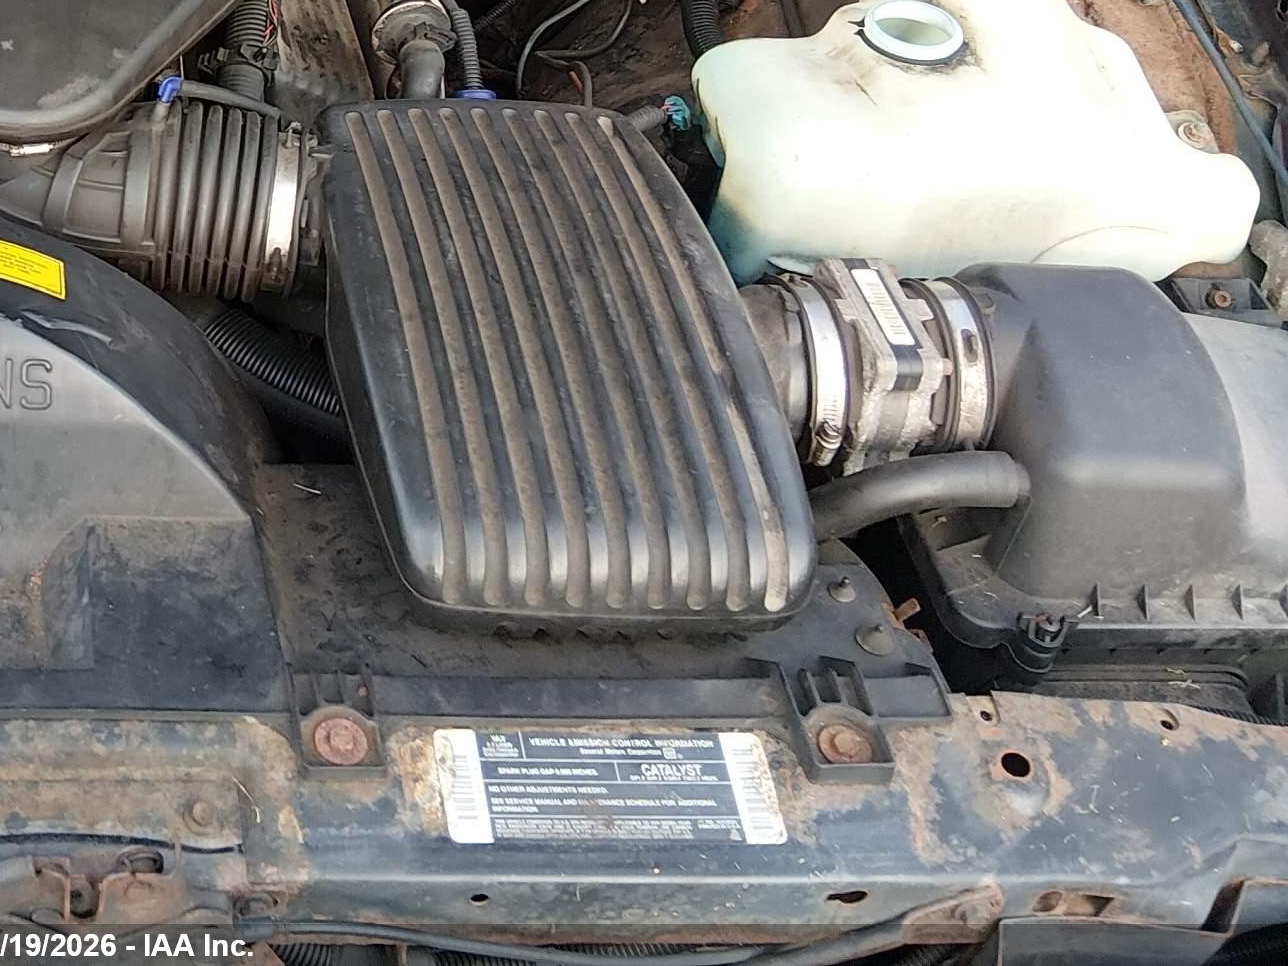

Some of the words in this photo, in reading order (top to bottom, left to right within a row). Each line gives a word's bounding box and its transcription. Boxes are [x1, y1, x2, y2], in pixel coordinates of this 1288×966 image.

[529, 738, 566, 747] VEHICLE
[568, 738, 610, 747] EMISSION
[612, 739, 653, 747] CONTROL
[654, 739, 714, 748] INFORMATION
[641, 763, 703, 776] CATALYST
[526, 786, 578, 794] ADJUSTMENTS
[563, 798, 578, 806] AND
